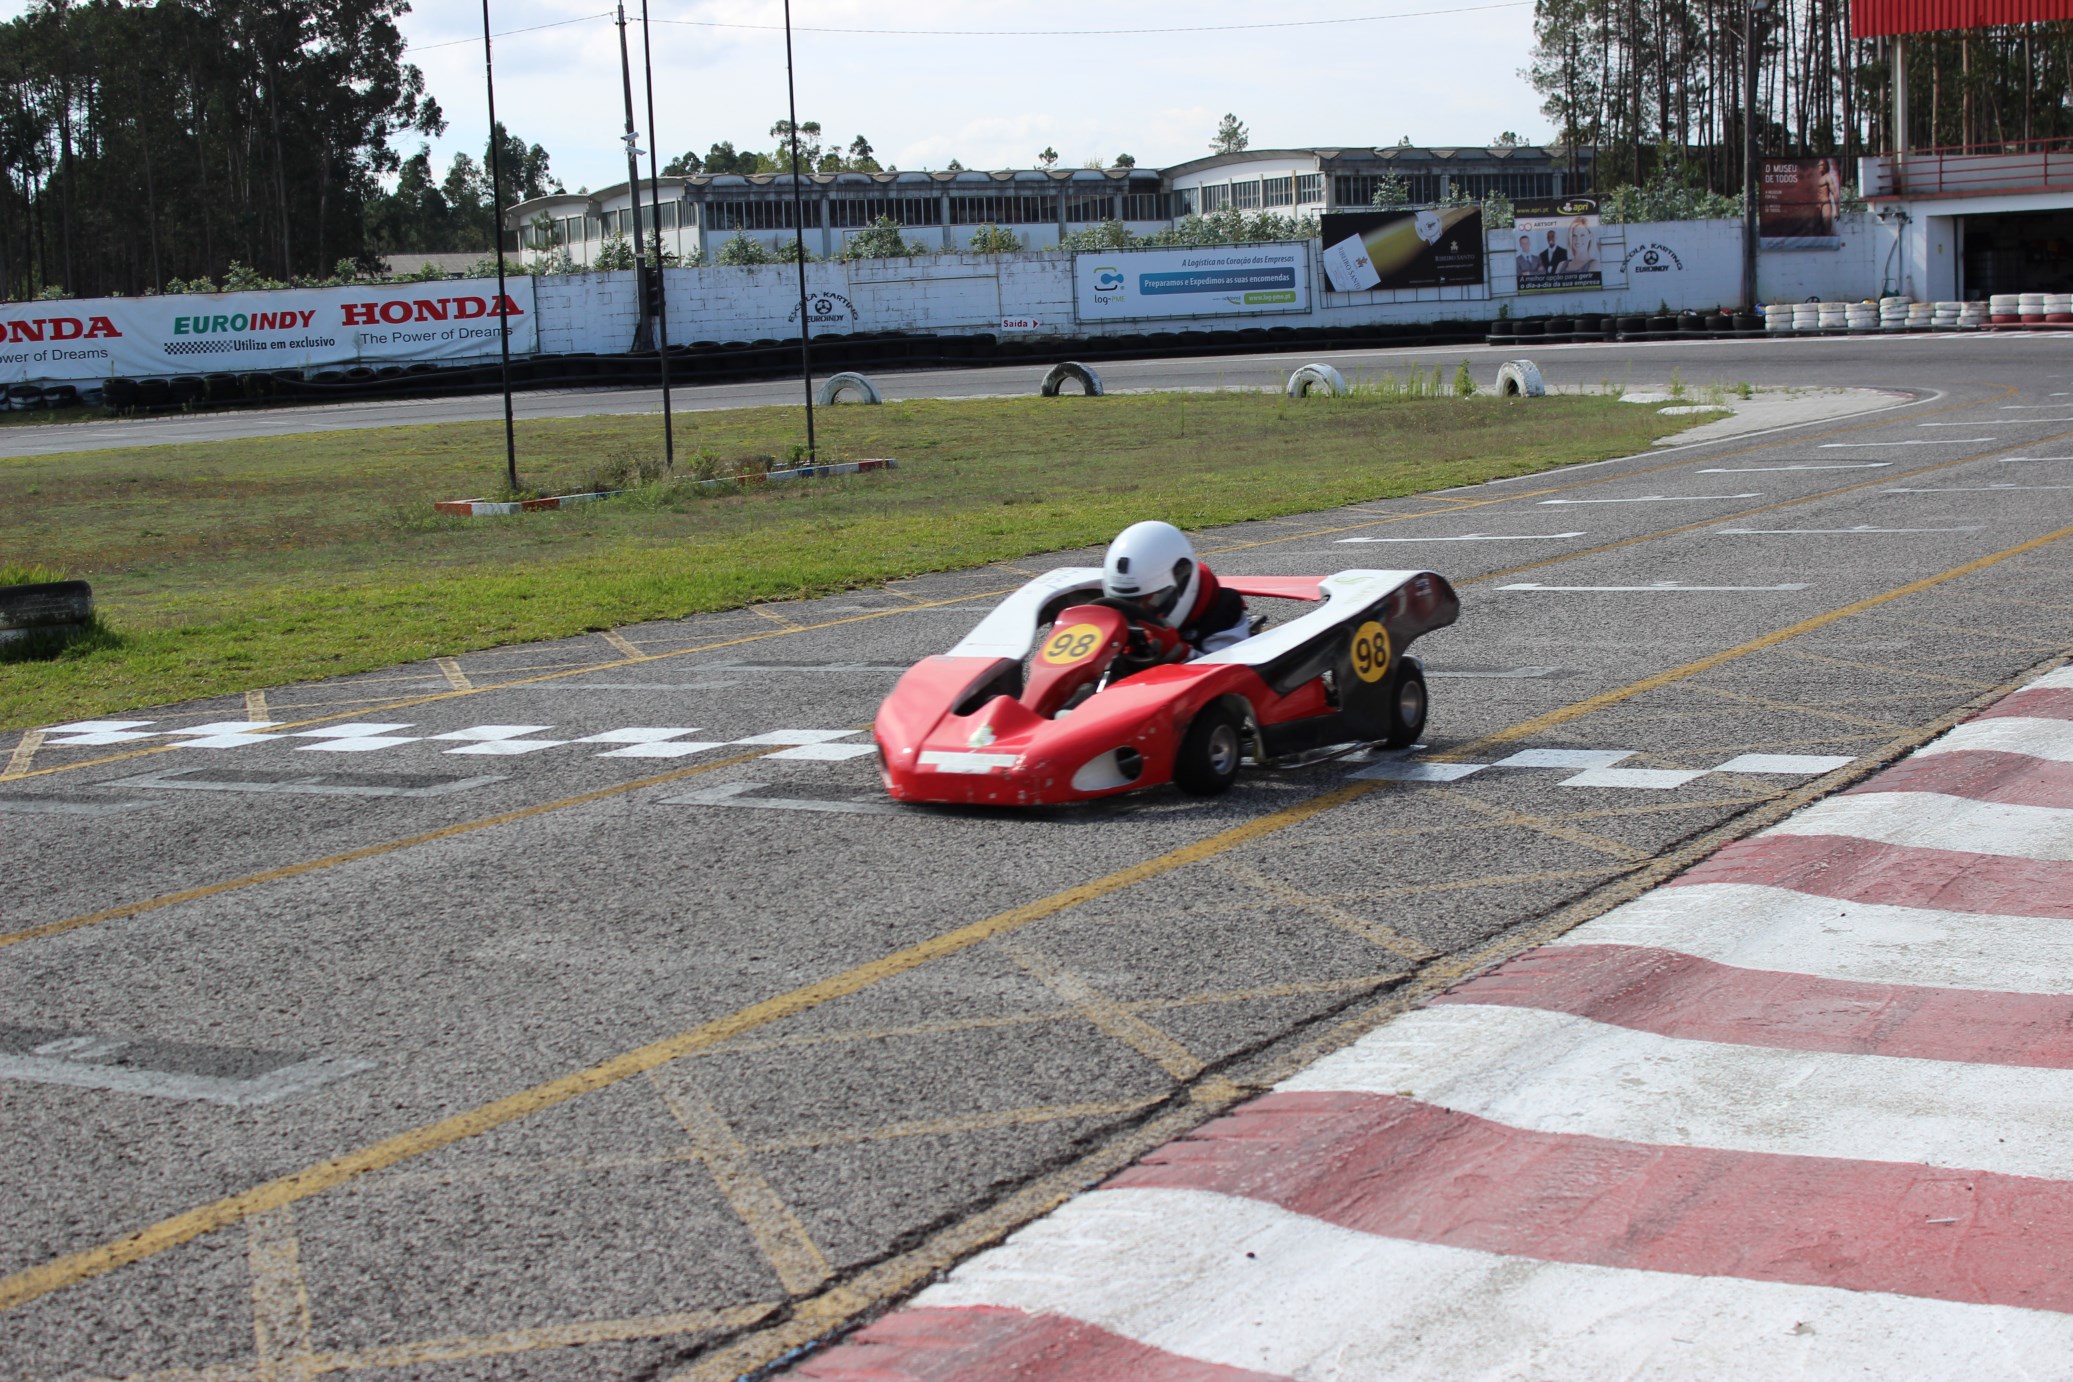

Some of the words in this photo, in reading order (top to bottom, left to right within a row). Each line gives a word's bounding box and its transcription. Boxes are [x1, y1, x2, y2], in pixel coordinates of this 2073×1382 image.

[1773, 164, 1797, 172] MUSEU
[1765, 175, 1773, 183] DE
[1776, 175, 1798, 183] TODOS
[1573, 203, 1588, 212] apri
[1226, 257, 1251, 266] Coração
[1265, 256, 1294, 264] Empresas
[1620, 245, 1646, 273] ESCOLA
[1651, 244, 1683, 270] KARTING
[1144, 279, 1183, 288] Preparamos
[1190, 277, 1224, 286] Expedimos
[1250, 274, 1289, 282] encomendas
[341, 295, 524, 326] HONDA
[824, 292, 858, 320] KARTING
[0, 316, 122, 343] NDA
[174, 310, 316, 335] EUROINDY
[234, 338, 267, 351] Utiliza
[271, 340, 286, 350] em
[290, 336, 335, 349] exclusivo
[361, 333, 387, 345] The
[393, 330, 435, 343] Power
[442, 328, 455, 340] of
[34, 350, 47, 361] of
[52, 349, 108, 361] Dreams
[1047, 633, 1097, 657] 98
[1356, 632, 1386, 674] 98
